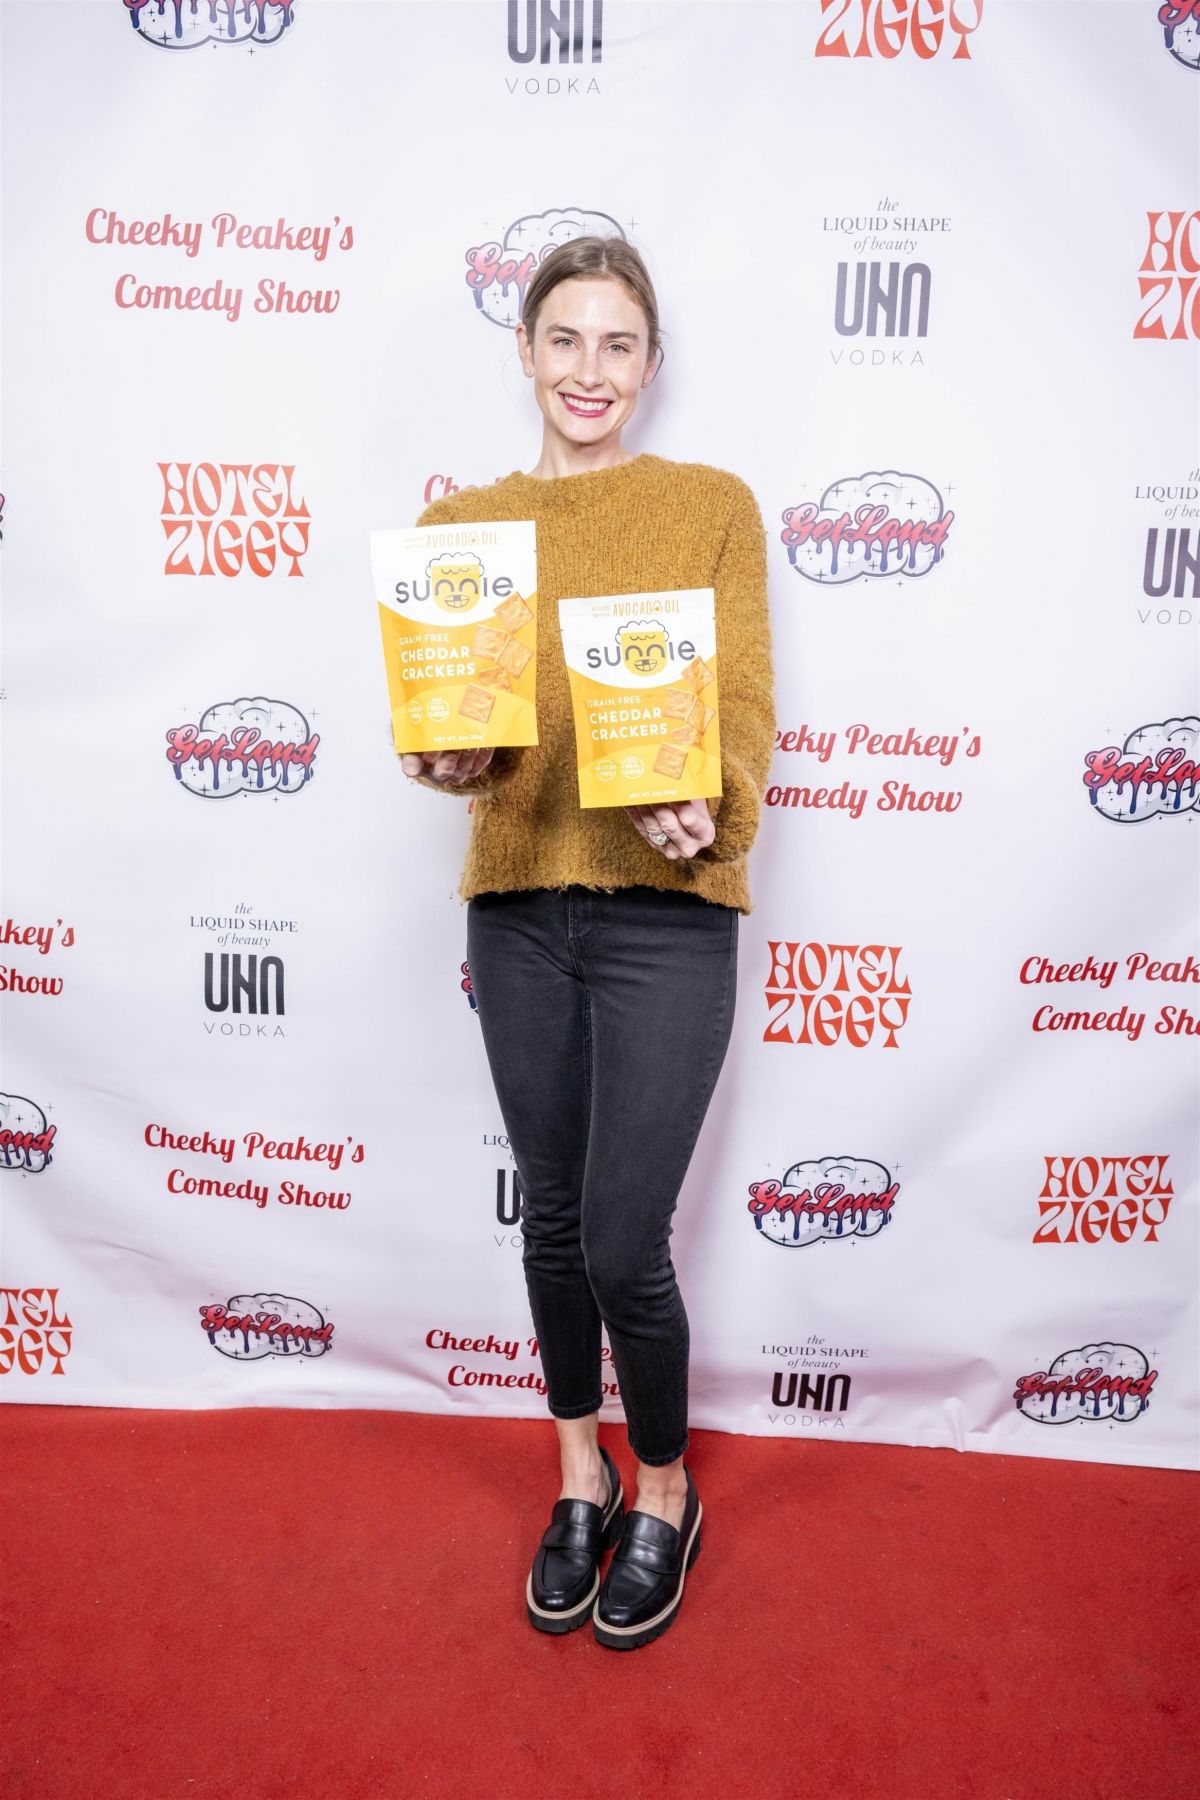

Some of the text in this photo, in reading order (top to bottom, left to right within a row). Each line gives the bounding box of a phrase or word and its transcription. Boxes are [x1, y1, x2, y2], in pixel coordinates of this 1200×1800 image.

[815, 0, 984, 60] ZIGGY
[505, 77, 601, 95] VODKA
[877, 197, 899, 212] the
[85, 208, 354, 262] Cheeky Peakey's
[823, 217, 952, 235] LIQUID SHAPE
[854, 236, 918, 254] of beauty
[114, 274, 341, 323] Comedy Show
[830, 350, 925, 366] VODKA
[157, 462, 311, 519] HOTEL
[1135, 486, 1199, 503] LIQUID
[1164, 504, 1180, 521] of
[161, 520, 311, 577] ZIGGY
[395, 576, 513, 604] sunnie
[613, 600, 681, 617] AVOCADO OIL
[1138, 610, 1200, 624] VOD
[399, 633, 449, 646] GRAIN FREE
[401, 646, 470, 664] CHEDDAR
[586, 640, 696, 669] sunnie
[402, 663, 476, 681] CRACKERS
[587, 696, 641, 708] GRAIN FREE
[589, 707, 663, 725] CHEDDAR
[591, 723, 668, 741] CRACKERS
[845, 724, 981, 766] Peakey's
[765, 780, 963, 819] omedy Show
[235, 902, 253, 915] the
[190, 916, 298, 933] LIQUID SHAPE
[217, 933, 271, 949] of beauty
[765, 941, 912, 994] HOTEL
[1019, 956, 1118, 989] Cheeky
[763, 991, 911, 1048] ZIGGY
[1032, 1005, 1147, 1041] Comedy
[203, 1022, 285, 1038] VODKA
[144, 1123, 365, 1171] Cheeky Peakey's
[1042, 1155, 1174, 1198] HOTEL
[167, 1168, 351, 1210] Comedy Show
[1032, 1198, 1174, 1243] ZIGGY
[426, 1329, 520, 1361] Cheeky
[807, 1334, 825, 1345] the
[762, 1345, 869, 1358] LIQUID SHAPE
[787, 1358, 840, 1371] of beauty
[448, 1365, 548, 1396] Comedy
[768, 1414, 845, 1429] VODKA
